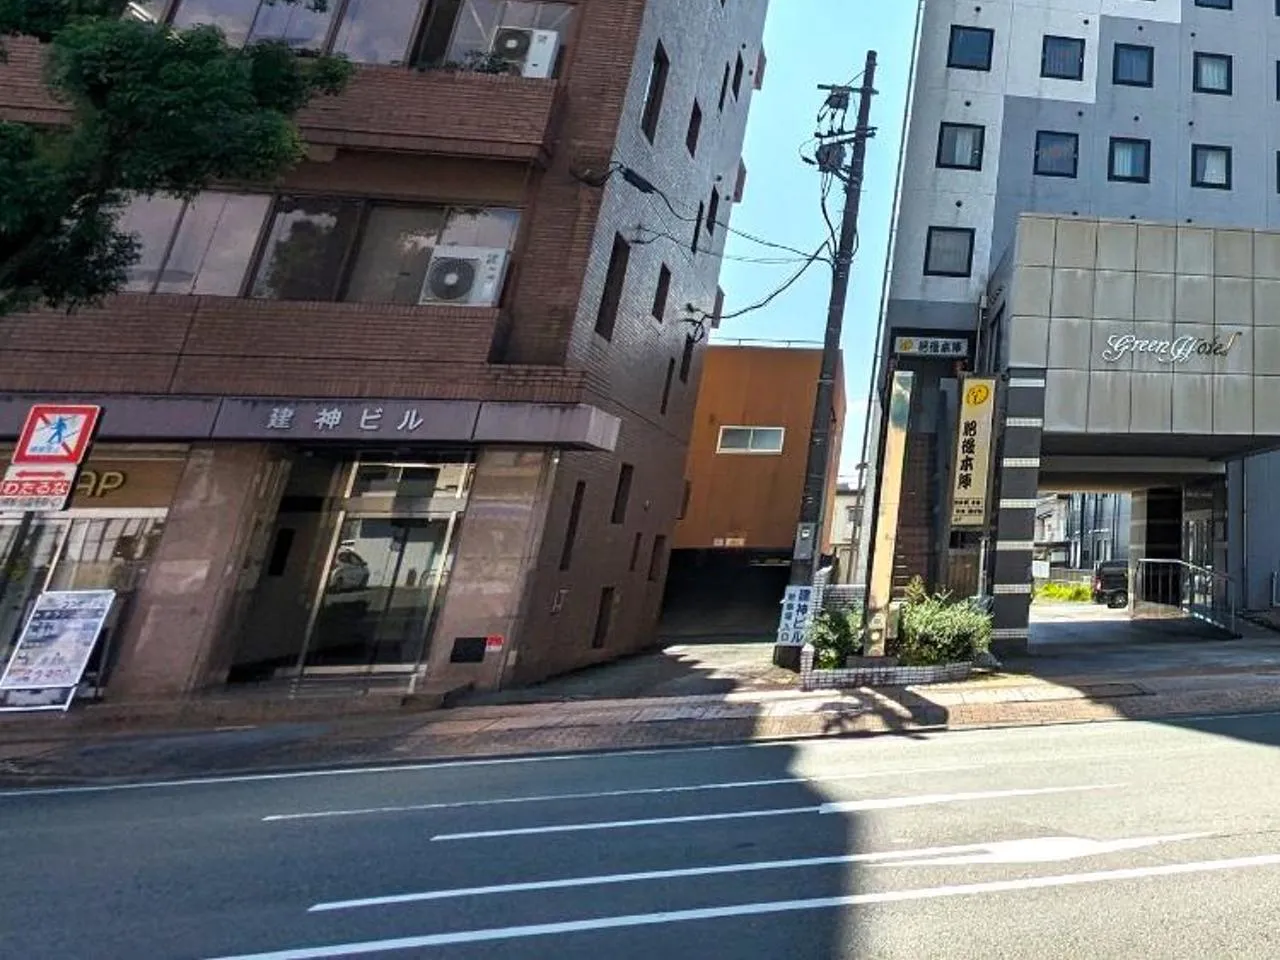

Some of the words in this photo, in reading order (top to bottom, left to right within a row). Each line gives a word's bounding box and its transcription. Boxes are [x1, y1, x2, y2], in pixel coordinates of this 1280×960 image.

[1102, 334, 1170, 362] Green
[266, 407, 424, 431] 建神ビル
